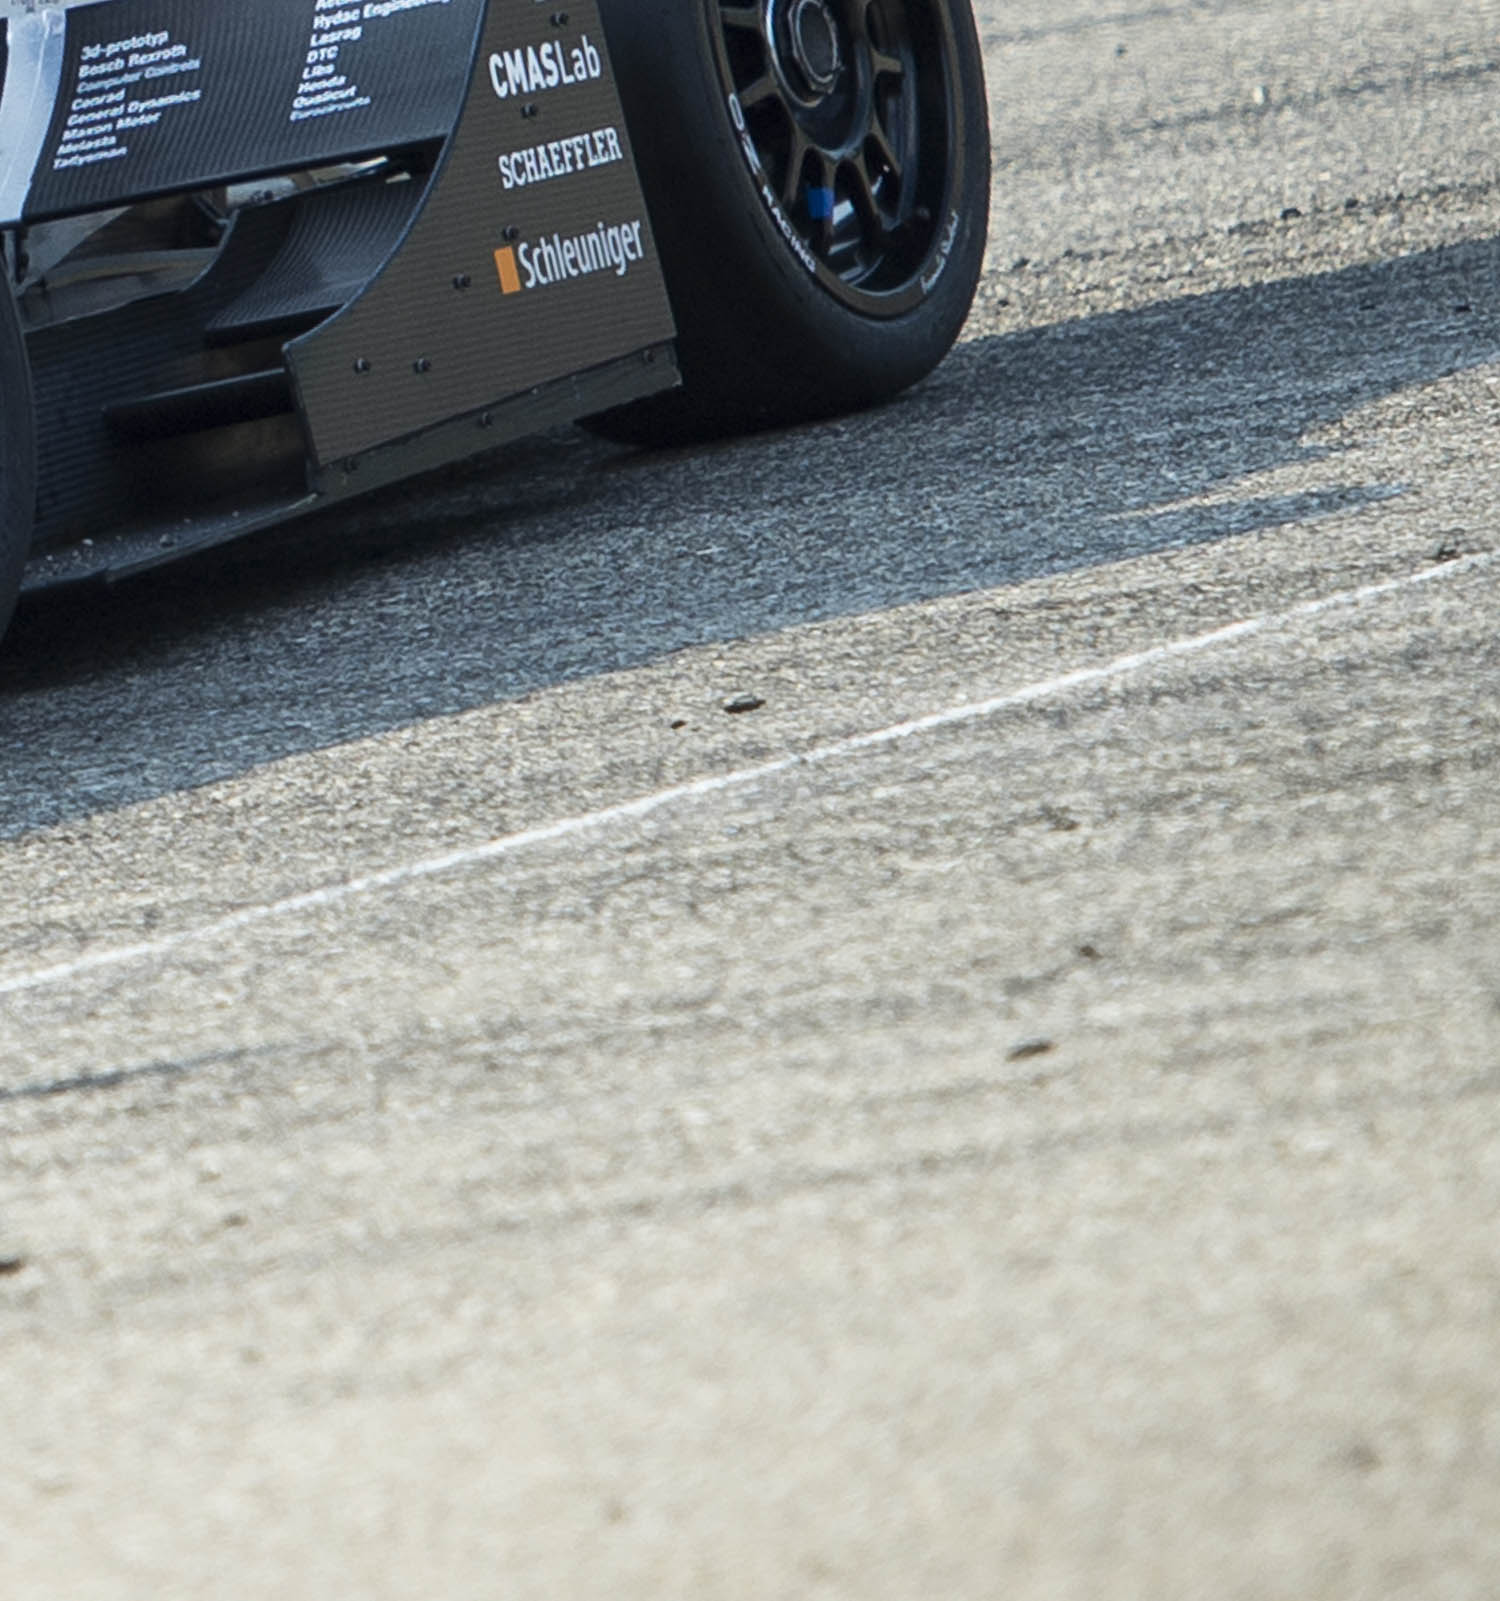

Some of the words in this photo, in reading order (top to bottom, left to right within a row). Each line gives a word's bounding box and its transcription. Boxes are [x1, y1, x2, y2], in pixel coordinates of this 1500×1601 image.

[488, 35, 602, 99] CMASLab
[498, 126, 623, 190] SCHAEFFLER
[517, 219, 644, 289] Schleuniger
